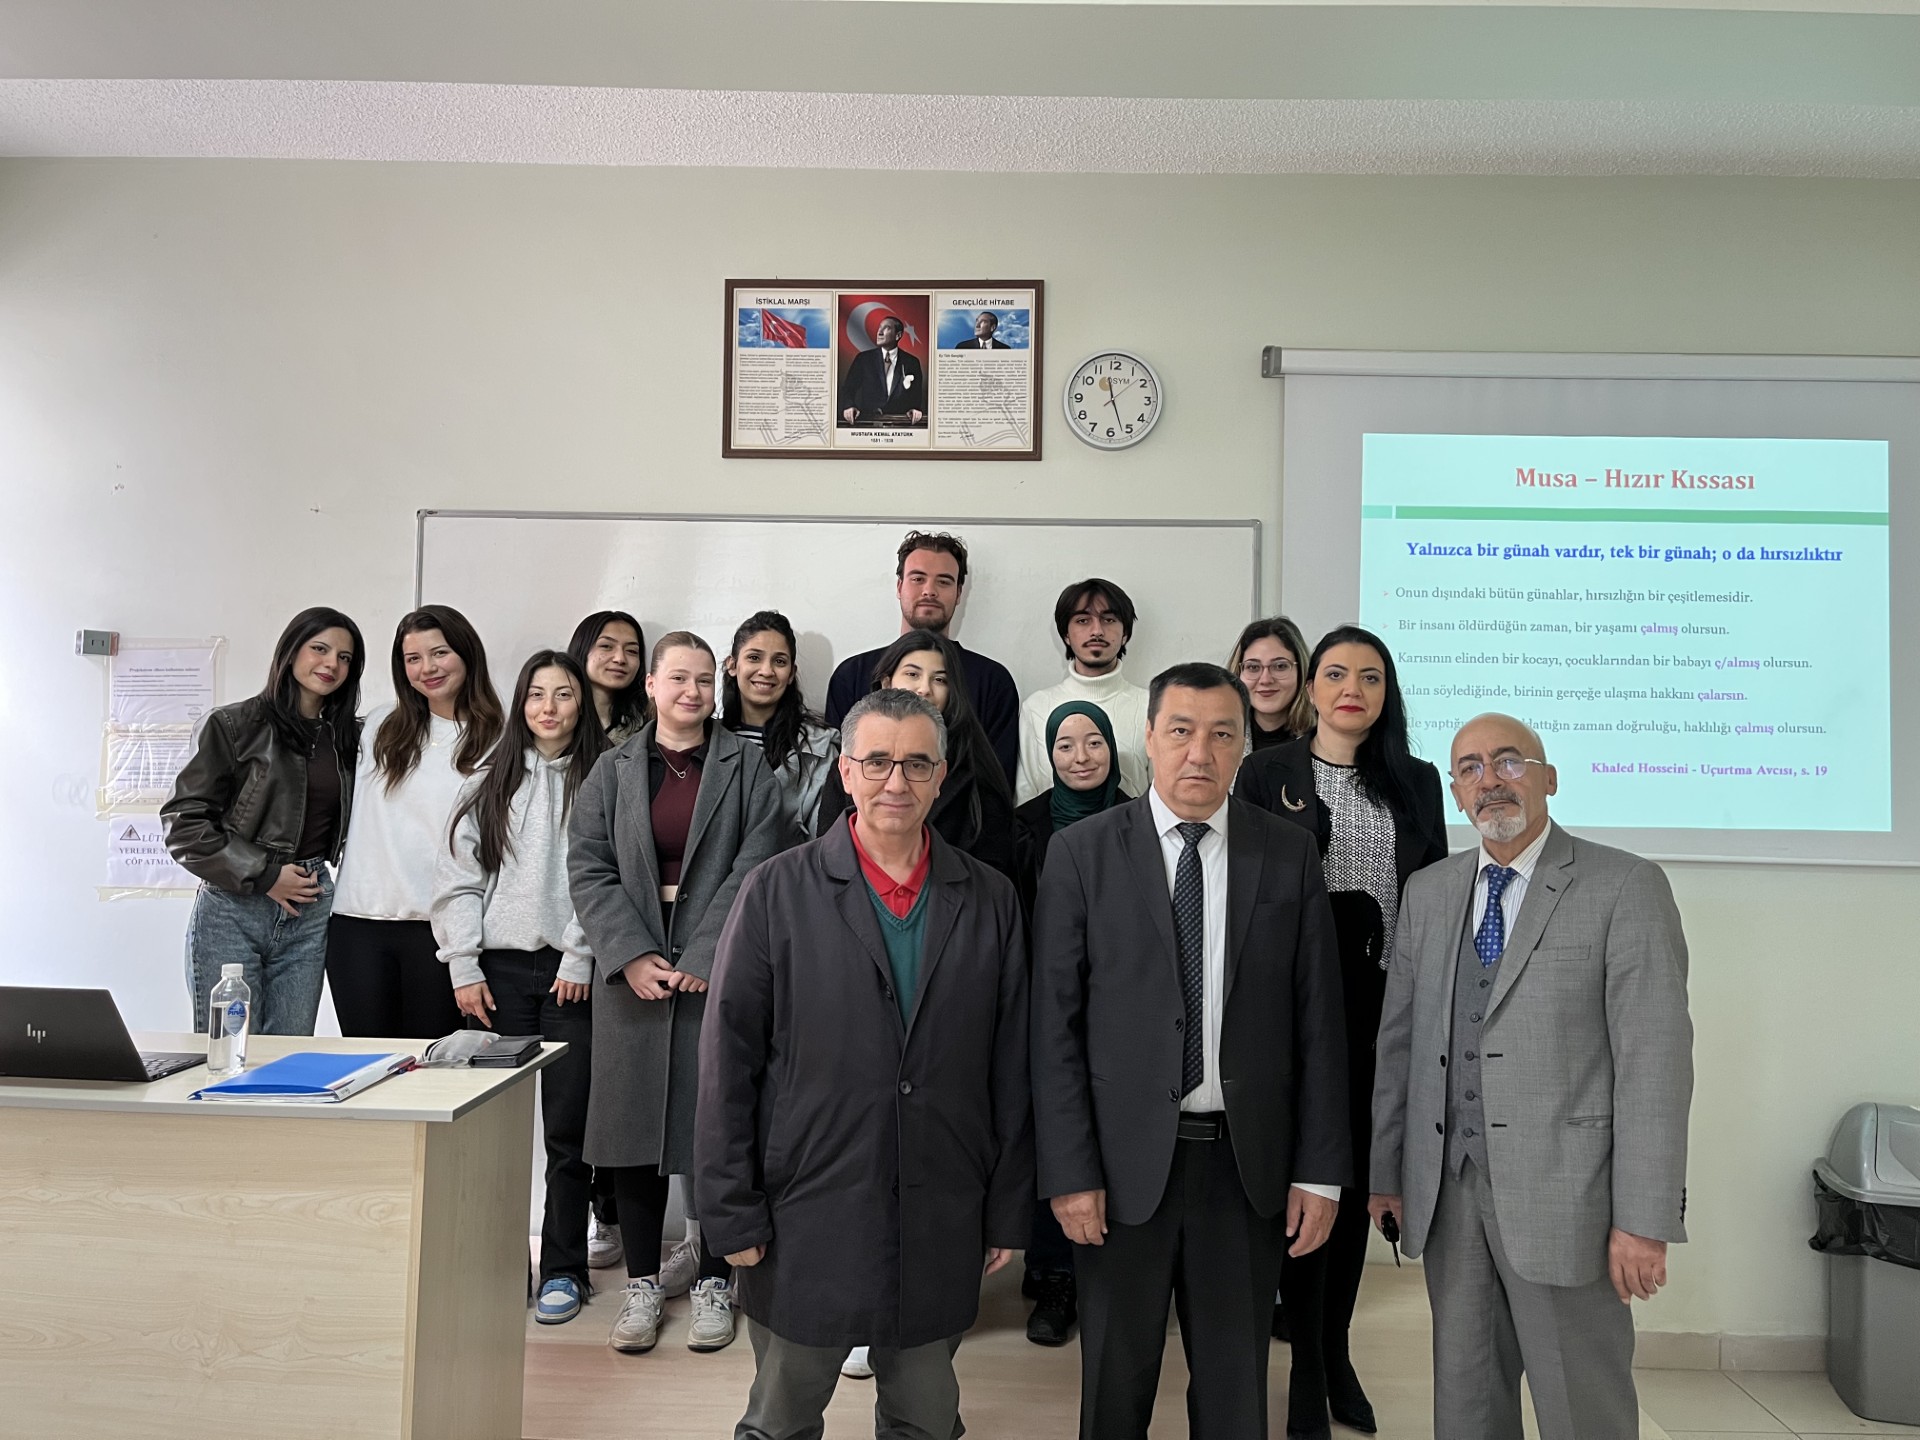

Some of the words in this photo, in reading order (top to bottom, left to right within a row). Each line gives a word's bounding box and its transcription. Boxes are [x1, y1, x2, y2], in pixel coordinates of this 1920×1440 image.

[755, 297, 786, 305] İSTİKLAL
[788, 298, 810, 306] MARŞI
[952, 298, 988, 307] GENÇLİĞE
[989, 298, 1015, 306] HİTABE
[1095, 364, 1102, 375] 11
[1110, 361, 1122, 371] 12
[1131, 366, 1134, 376] 1
[1083, 376, 1094, 386] 10
[1139, 378, 1147, 388] 2
[1074, 393, 1084, 403] 9
[1144, 396, 1152, 406] 3
[1078, 410, 1087, 420] 8
[1137, 413, 1146, 423] 4
[1089, 422, 1098, 432] 7
[1125, 424, 1133, 434] 5
[1106, 427, 1115, 438] 6
[1516, 468, 1578, 488] Musa
[1605, 468, 1665, 489] Hızır
[1671, 469, 1755, 490] Kıssası
[1407, 542, 1473, 556] Yalnızca
[1478, 543, 1499, 557] bir
[1503, 544, 1550, 560] günah
[1555, 545, 1605, 561] vardır,
[1610, 545, 1634, 559] tek
[1639, 545, 1660, 559] bir
[1665, 547, 1716, 563] günah;
[1722, 550, 1732, 560] o
[1737, 547, 1755, 560] da
[1760, 548, 1843, 562] hırsızlıktır
[1396, 587, 1428, 598] Onun
[1432, 588, 1486, 600] dışındaki
[1490, 588, 1524, 599] bütün
[1527, 588, 1582, 602] günahlar,
[1586, 588, 1644, 604] hırsızlığın
[1649, 590, 1665, 602] bir
[1668, 591, 1753, 605] çeşitlemesidir.
[1399, 620, 1416, 630] Bir
[1420, 620, 1455, 630] insanı
[1459, 620, 1527, 633] öldürdüğün
[1530, 623, 1572, 634] zaman,
[1576, 621, 1592, 633] bir
[1595, 623, 1637, 635] yaşamı
[1640, 623, 1678, 636] çalmış
[1681, 624, 1730, 635] olursun.
[1398, 653, 1452, 664] Karısının
[1455, 653, 1499, 664] elinden
[1503, 653, 1519, 665] bir
[1522, 654, 1562, 666] kocayı,
[1565, 655, 1650, 668] çocuklarından
[1653, 655, 1671, 666] bir
[1673, 656, 1711, 668] babayı
[1715, 656, 1760, 670] ç/almış
[1763, 658, 1812, 668] olursun.
[1434, 685, 1511, 698] söylediğinde,
[1515, 686, 1553, 697] birinin
[1557, 688, 1601, 700] gerçeğe
[1604, 687, 1647, 700] ulaşma
[1650, 687, 1694, 700] hakkını
[1698, 689, 1748, 702] çalarsın.
[1573, 722, 1613, 731] zaman
[1616, 720, 1681, 734] doğruluğu,
[1684, 721, 1732, 735] haklılığı
[1735, 722, 1774, 736] çalmış
[1778, 722, 1827, 734] olursun.
[1592, 762, 1634, 774] Khaled
[1638, 763, 1688, 774] Hosseini
[1700, 764, 1752, 778] Uçurtma
[1757, 765, 1797, 778] Avcısı,
[1801, 767, 1809, 775] s.
[1815, 766, 1828, 776] 19
